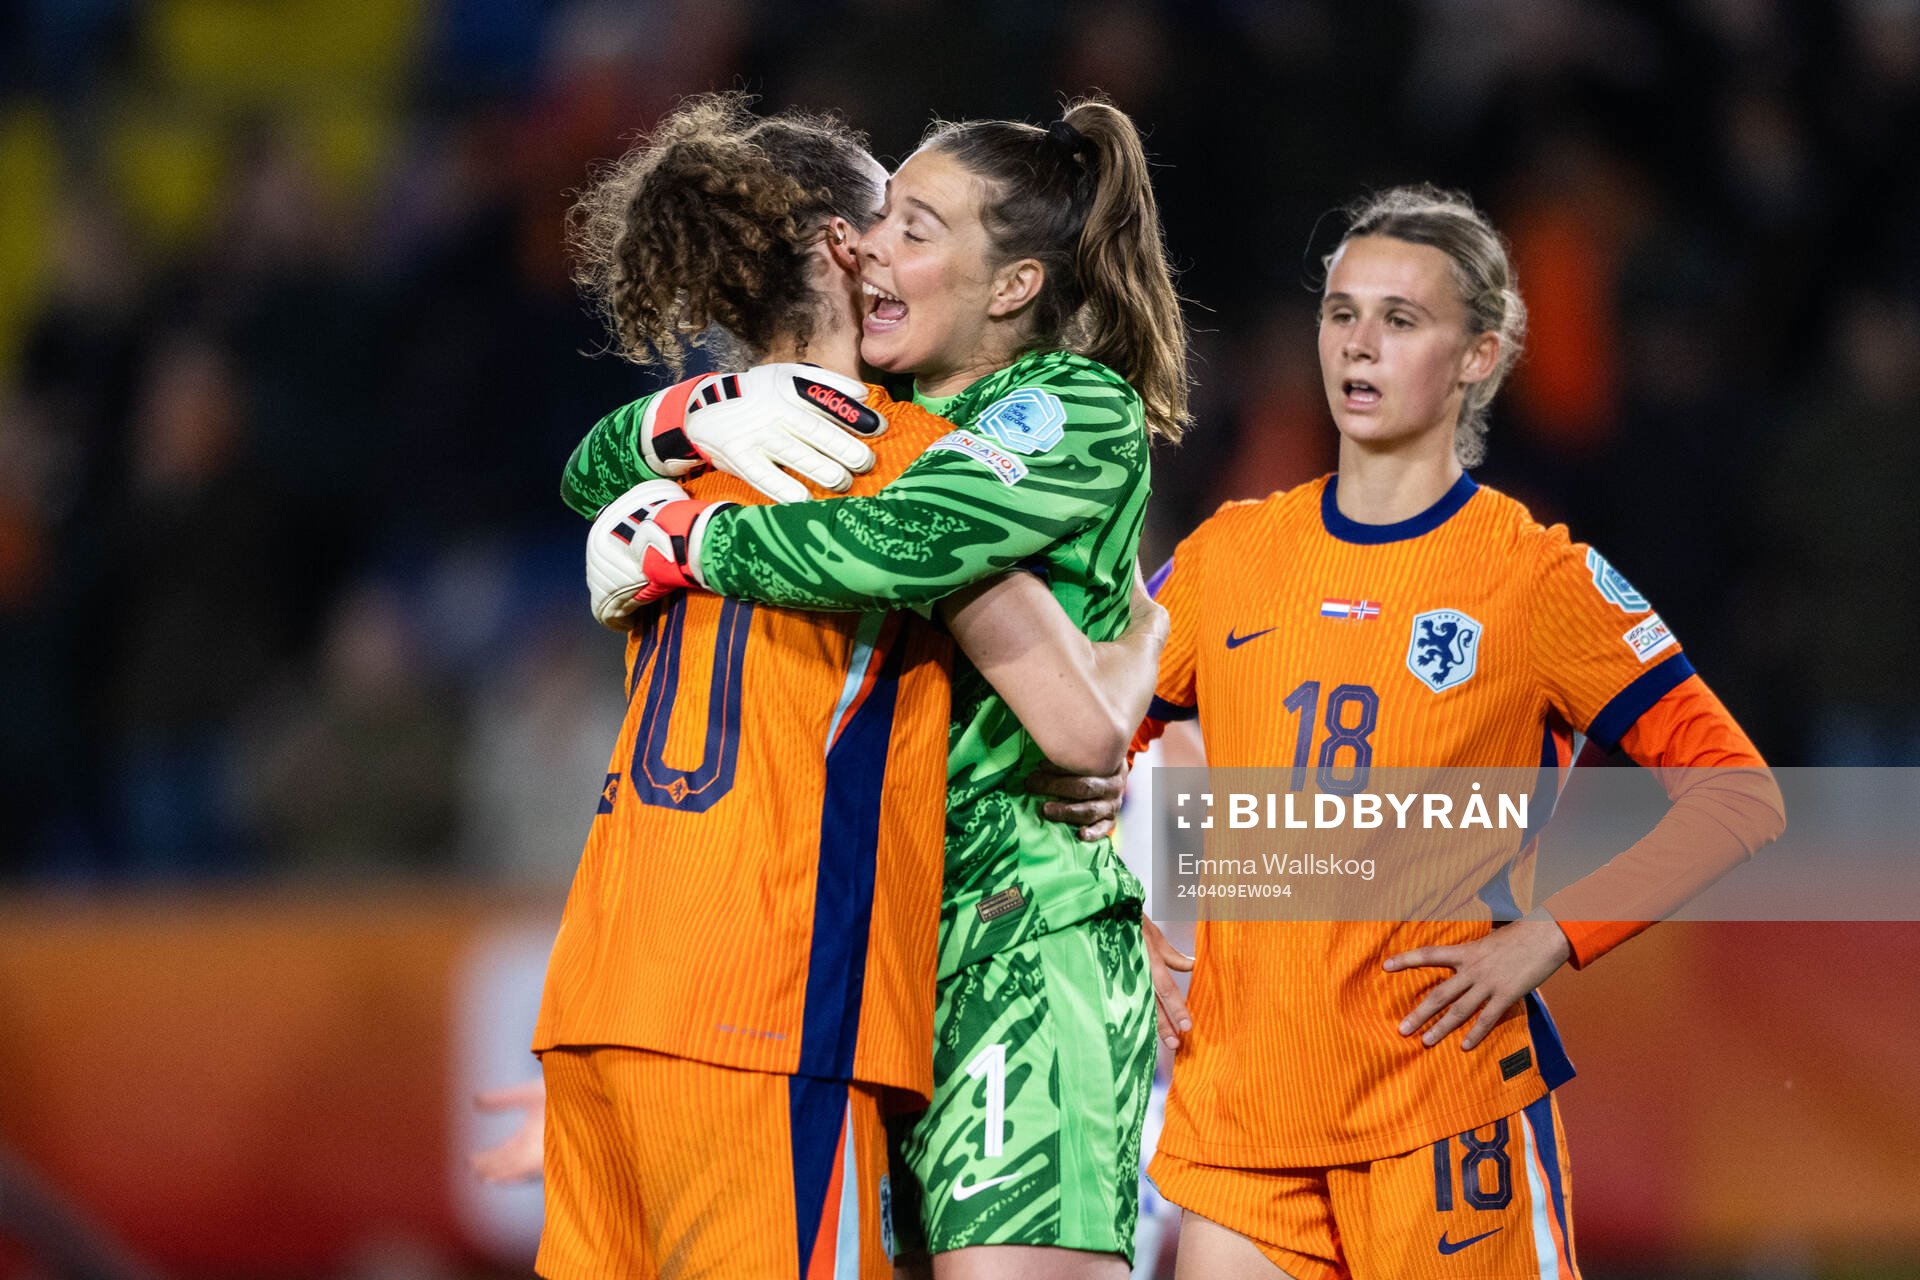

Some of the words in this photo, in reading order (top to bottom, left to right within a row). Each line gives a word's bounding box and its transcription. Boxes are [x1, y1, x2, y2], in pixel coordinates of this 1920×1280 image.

[807, 384, 861, 424] adidas
[1282, 680, 1379, 797] 18
[965, 1043, 1006, 1158] 1
[1433, 1117, 1513, 1212] 18
